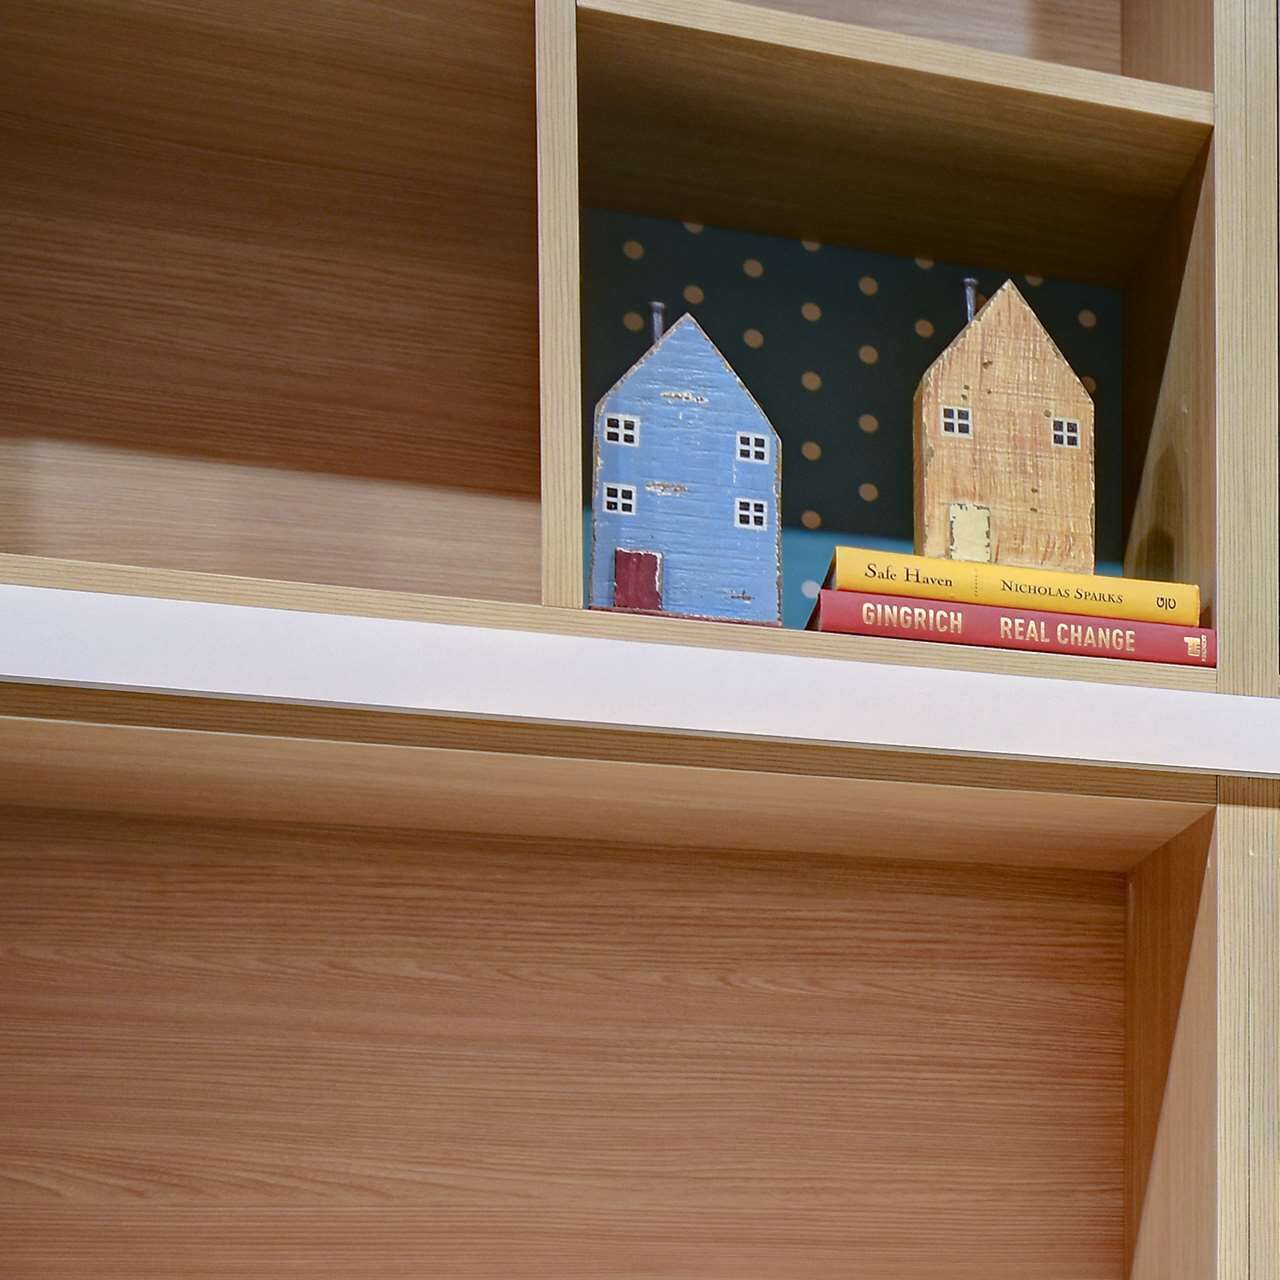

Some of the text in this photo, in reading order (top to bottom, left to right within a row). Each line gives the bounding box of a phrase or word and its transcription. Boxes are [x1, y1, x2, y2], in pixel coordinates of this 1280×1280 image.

[864, 563, 953, 588] Safe Haven
[1001, 579, 1124, 605] NICHOLAS SPARKS
[861, 602, 964, 635] GINGRICH
[1000, 618, 1136, 652] REAL CHANGE
